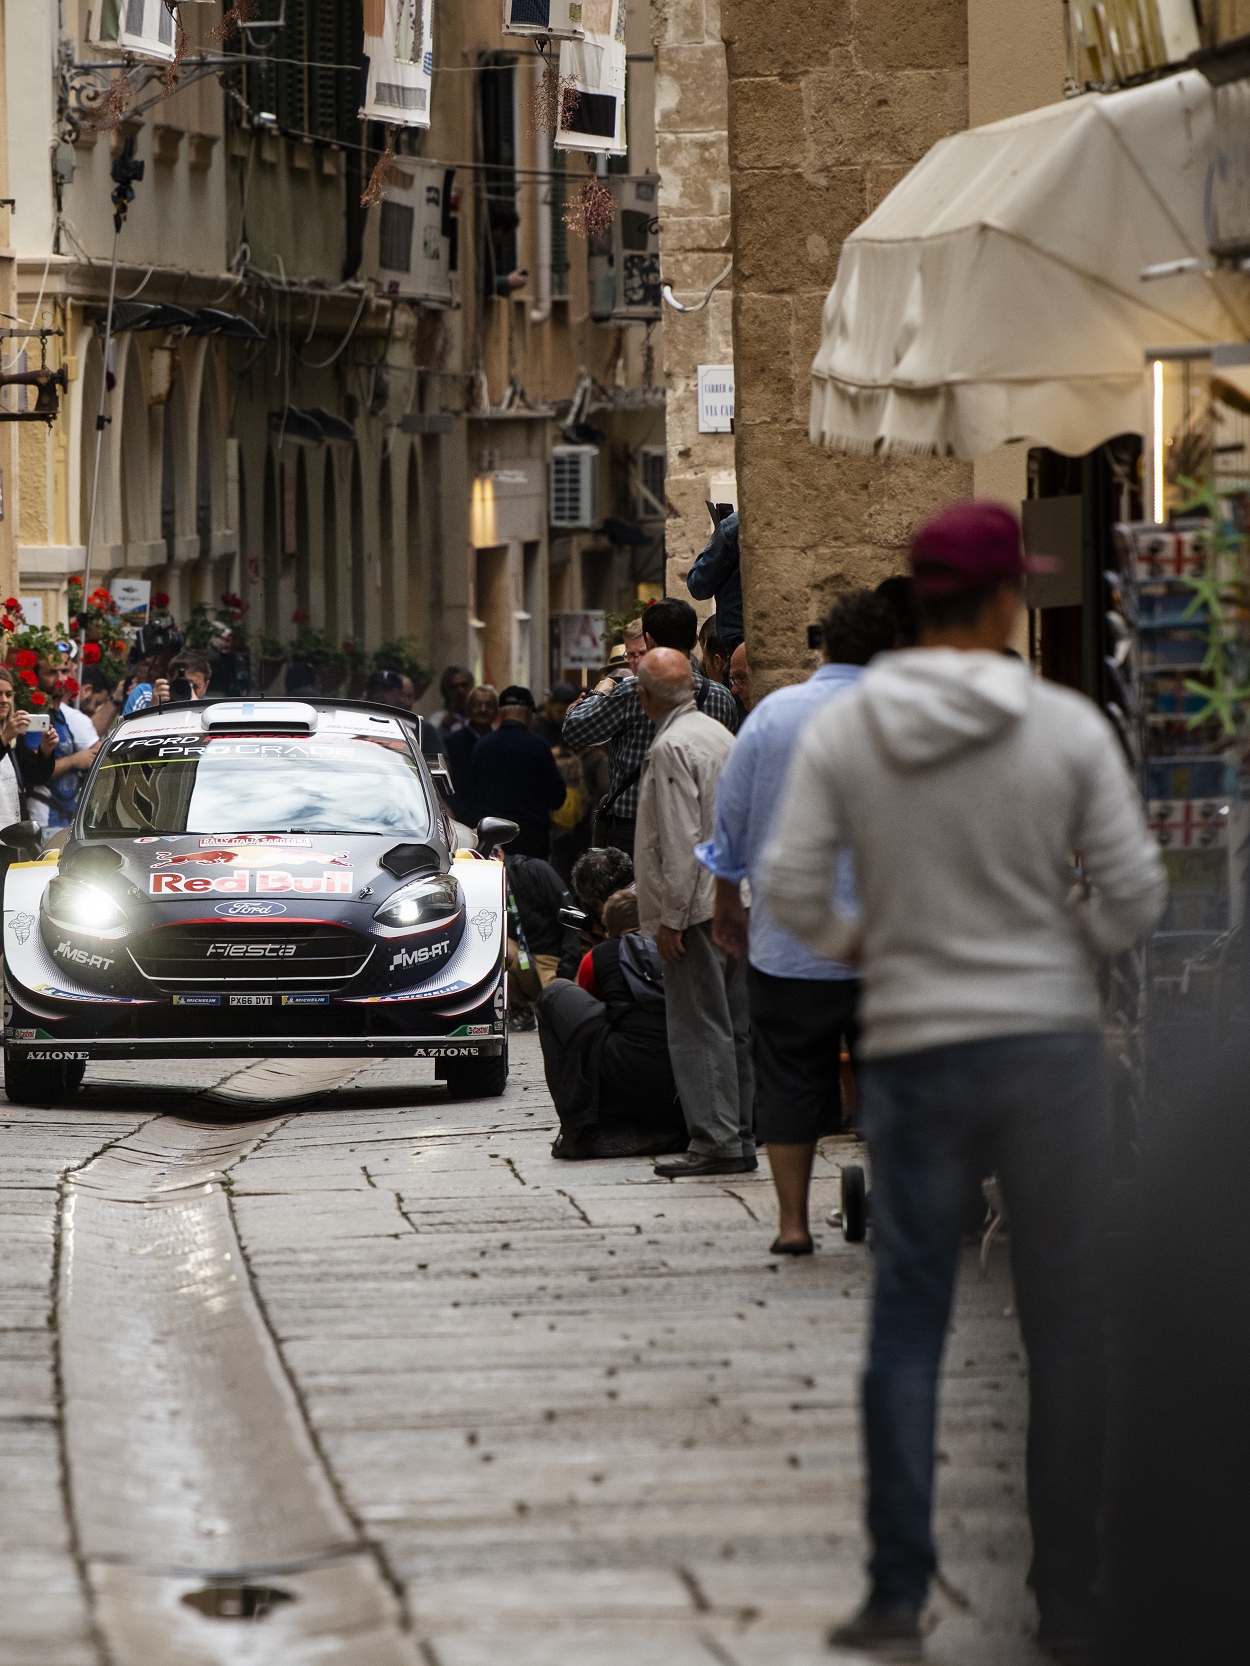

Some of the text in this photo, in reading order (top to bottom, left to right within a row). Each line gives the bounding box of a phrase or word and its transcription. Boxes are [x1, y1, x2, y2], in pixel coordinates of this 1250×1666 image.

[706, 405, 717, 416] VIA
[128, 736, 200, 748] FORD
[151, 871, 352, 893] Red Bull
[229, 902, 272, 915] Ford
[206, 943, 297, 957] Fiesta
[230, 996, 272, 1005] PX66 DVT
[472, 1025, 489, 1034] Castrol
[27, 1052, 90, 1060] AZIONE
[414, 1048, 479, 1057] AZIONE
